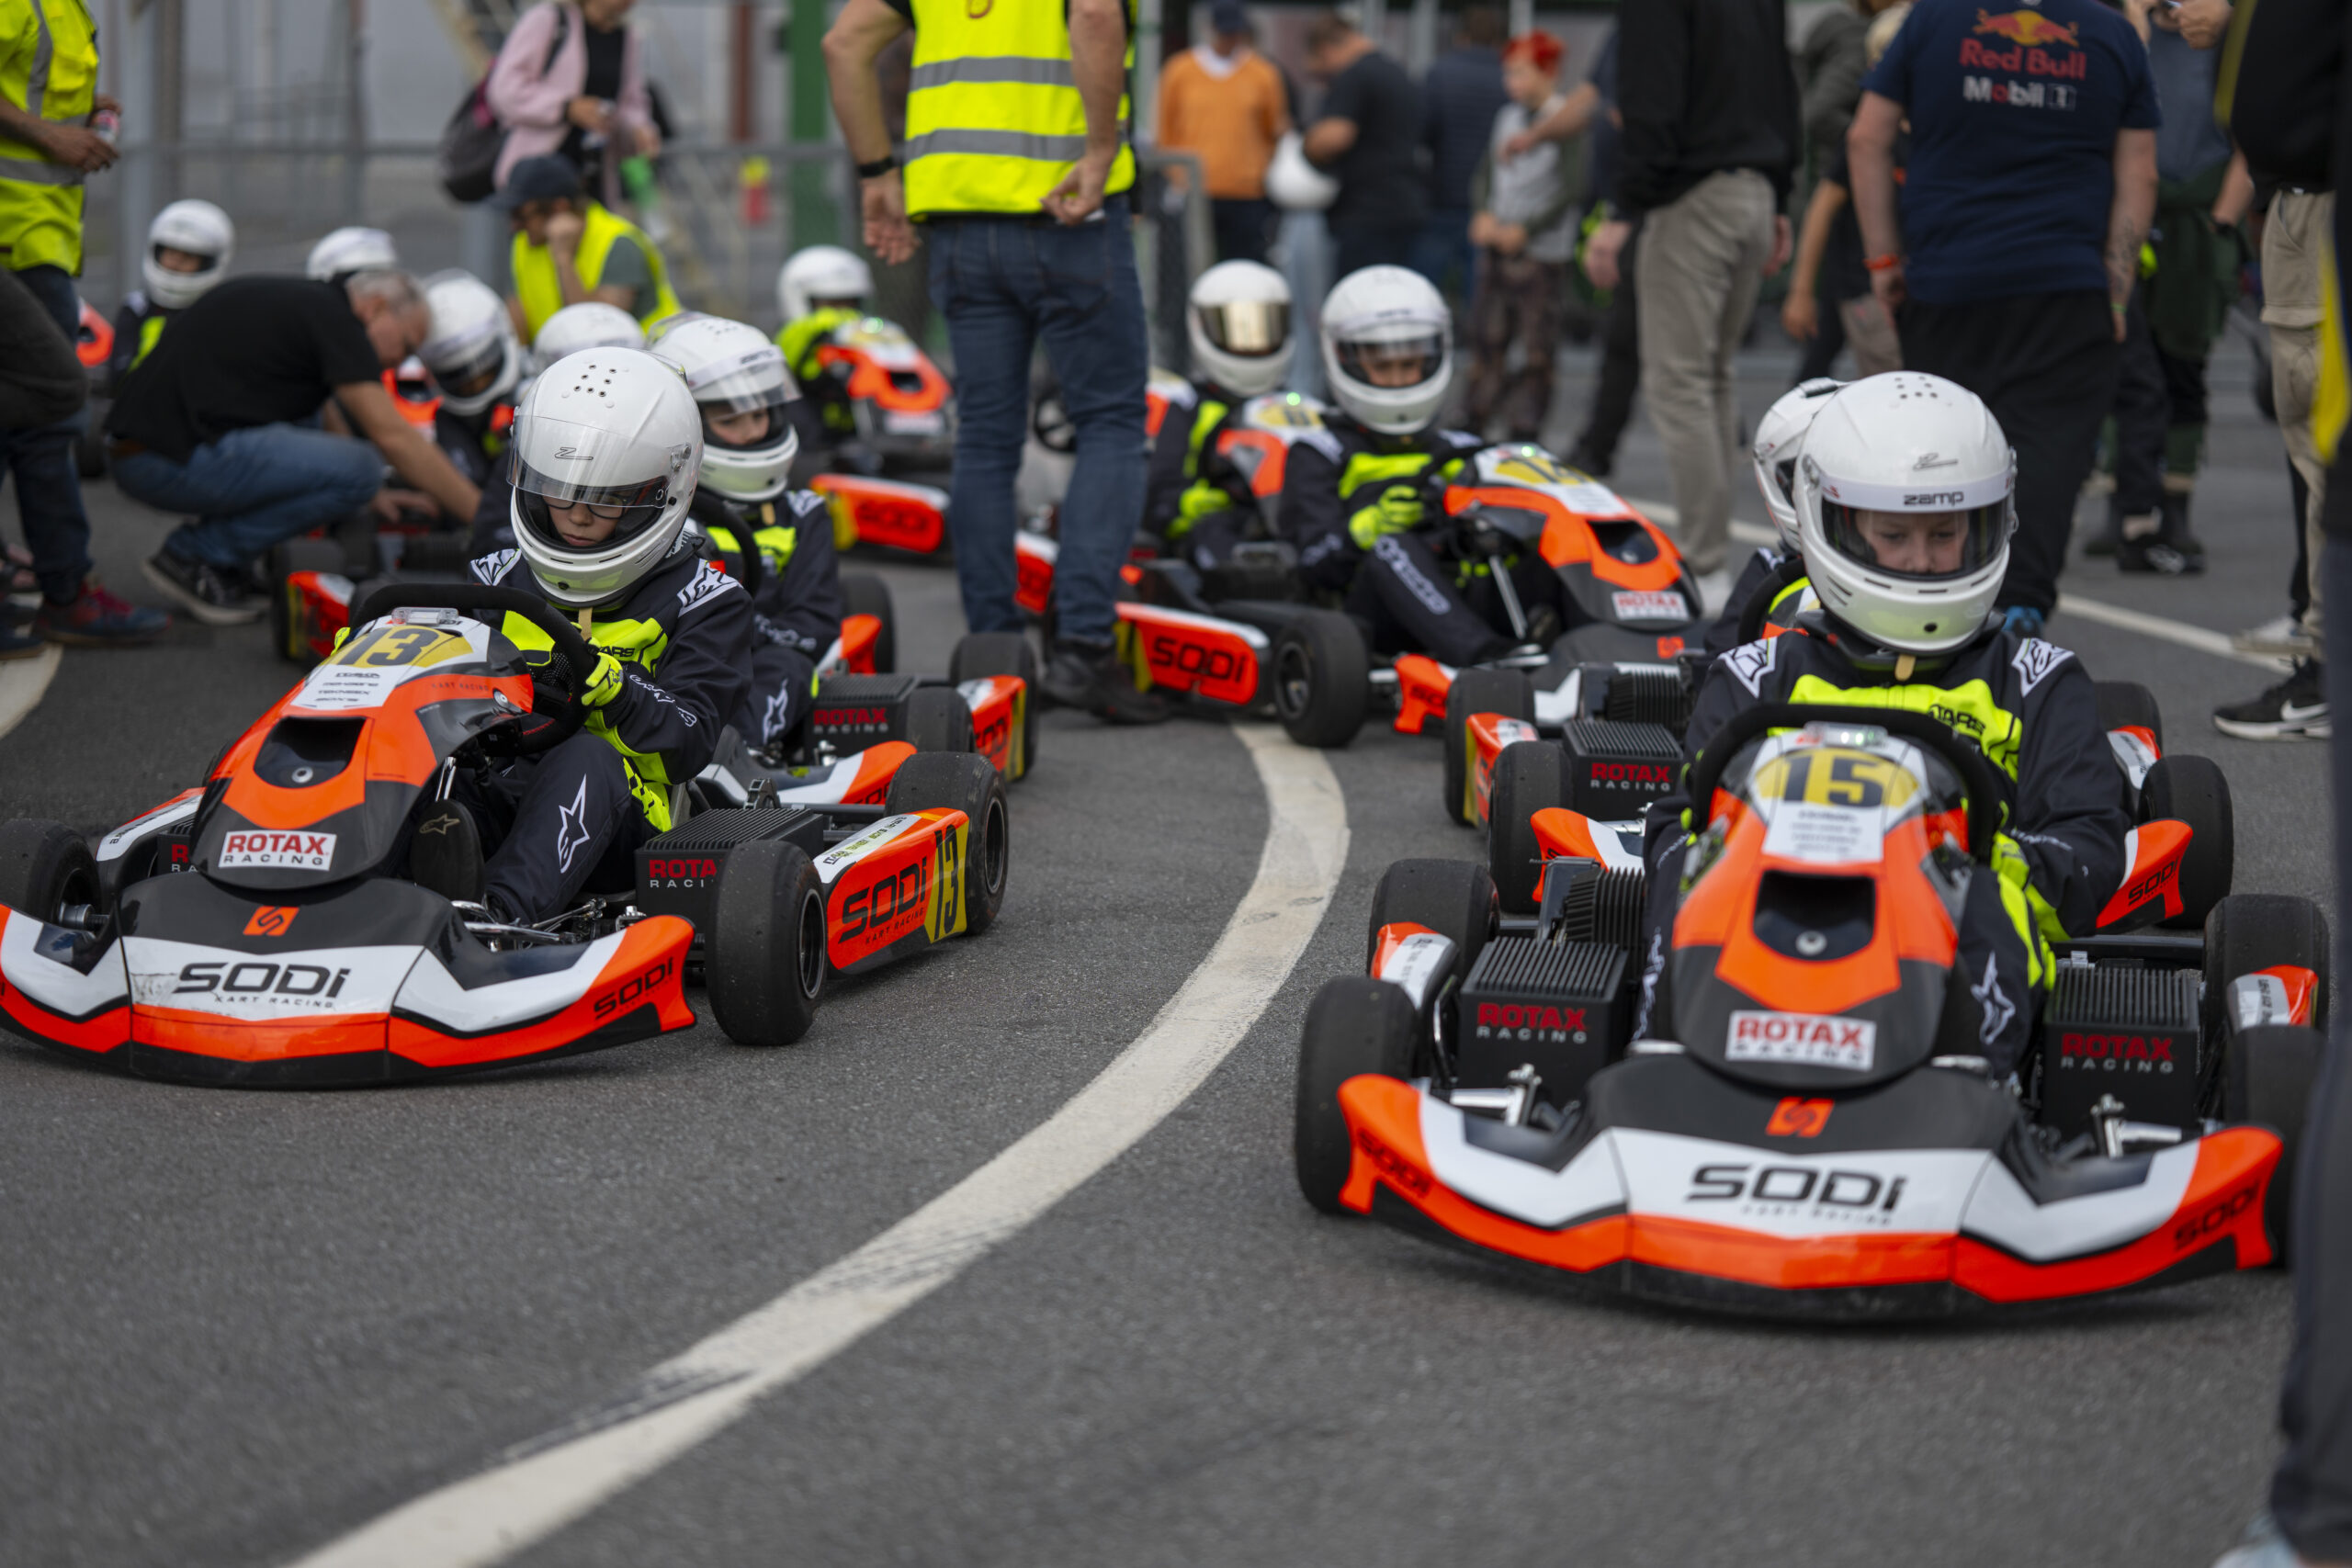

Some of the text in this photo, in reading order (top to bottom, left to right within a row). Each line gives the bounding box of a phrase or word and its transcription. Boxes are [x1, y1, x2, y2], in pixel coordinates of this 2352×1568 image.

[1960, 38, 2087, 81] Red Bull
[1962, 75, 2045, 108] Mobil
[338, 626, 439, 666] 13
[1151, 635, 1248, 682] SODI
[813, 707, 888, 726] ROTAX
[813, 724, 888, 733] RACING
[1591, 762, 1670, 783] ROTAX
[1783, 755, 1883, 808] 15
[1590, 779, 1671, 792] RACING
[226, 834, 328, 855] ROTAX
[223, 854, 324, 866] RACING
[649, 859, 717, 878] ROTA
[933, 824, 959, 942] 13
[865, 907, 925, 944] KART RACING
[215, 996, 334, 1009] KART RACING
[1477, 1002, 1588, 1032] ROTAX
[1476, 1026, 1588, 1043] RACING
[1736, 1017, 1862, 1048] ROTAX
[2062, 1033, 2173, 1061] ROTAX
[2060, 1056, 2174, 1073] RACING
